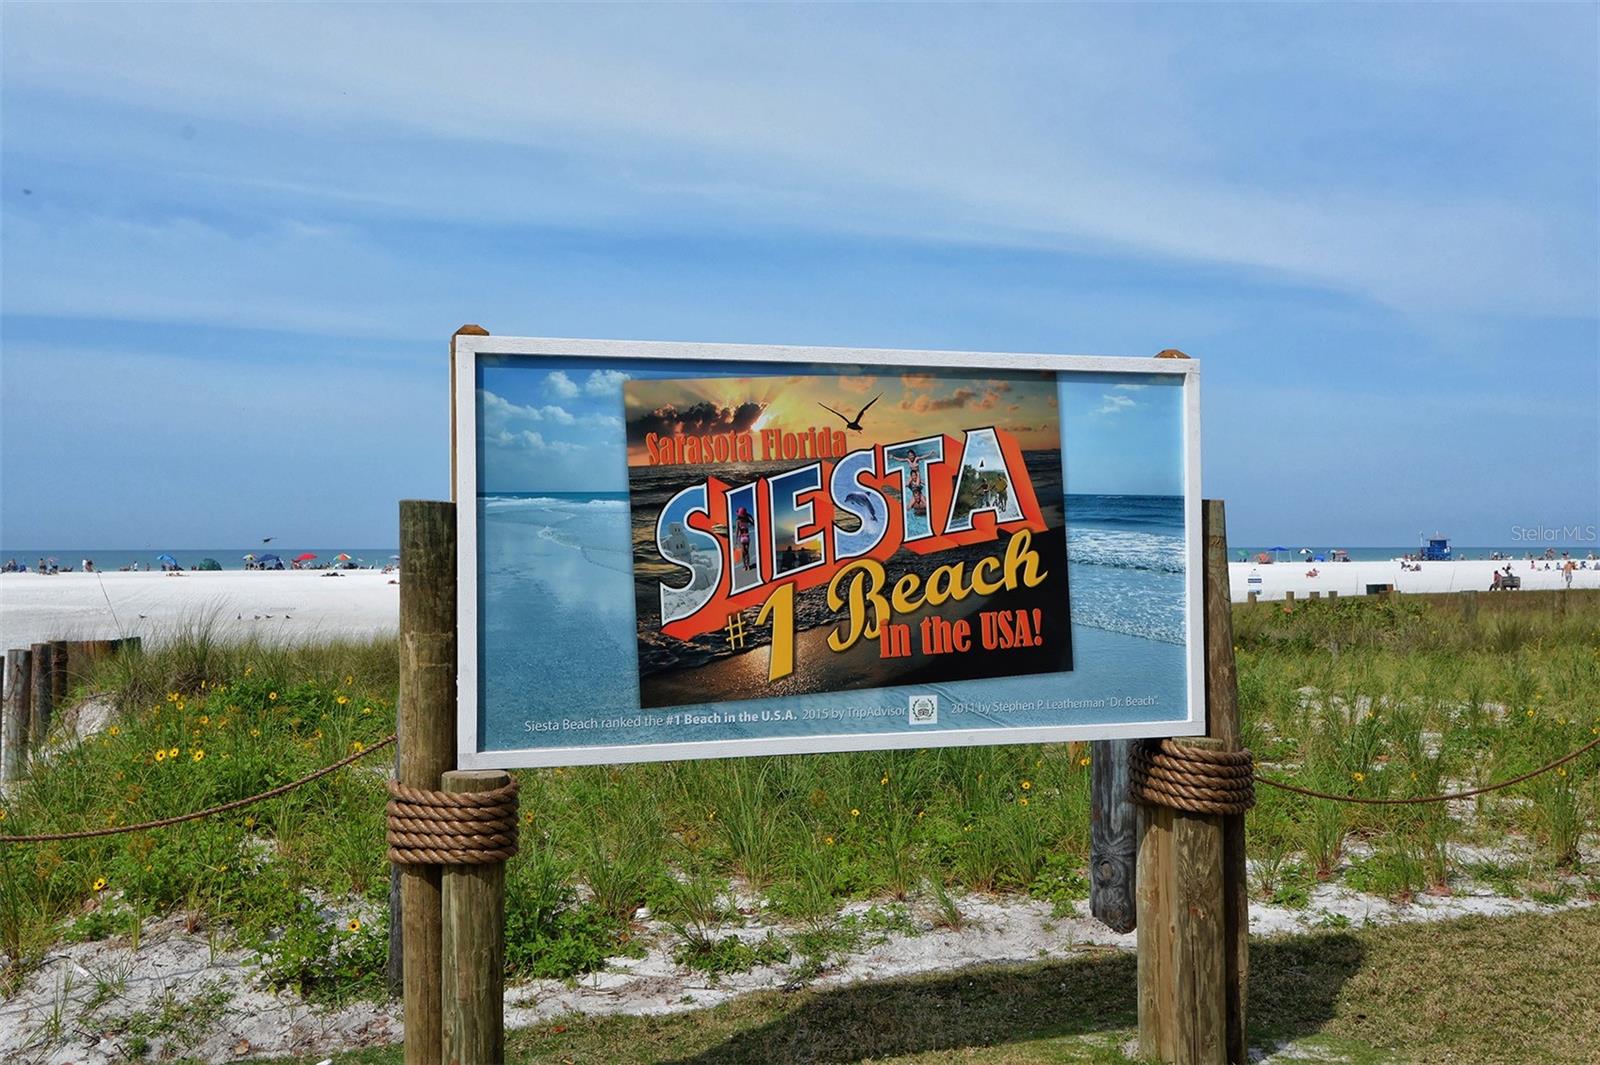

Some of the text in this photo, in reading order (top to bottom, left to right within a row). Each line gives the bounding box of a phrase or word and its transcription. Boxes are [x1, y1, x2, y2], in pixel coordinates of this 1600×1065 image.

[645, 426, 848, 466] Sarasota Florida
[656, 425, 1030, 628] SIESTA
[724, 528, 1048, 682] #1 Beach
[879, 608, 1043, 658] in the USA!
[524, 706, 906, 732] Siesta Beach ranked the #1 Beach in the U.S.A. 2015 by TripAdvisor
[951, 703, 975, 714] 2011
[978, 702, 991, 715] by
[993, 700, 1035, 713] Stephen
[1037, 700, 1044, 710] P.
[1046, 698, 1105, 710] Leatherman
